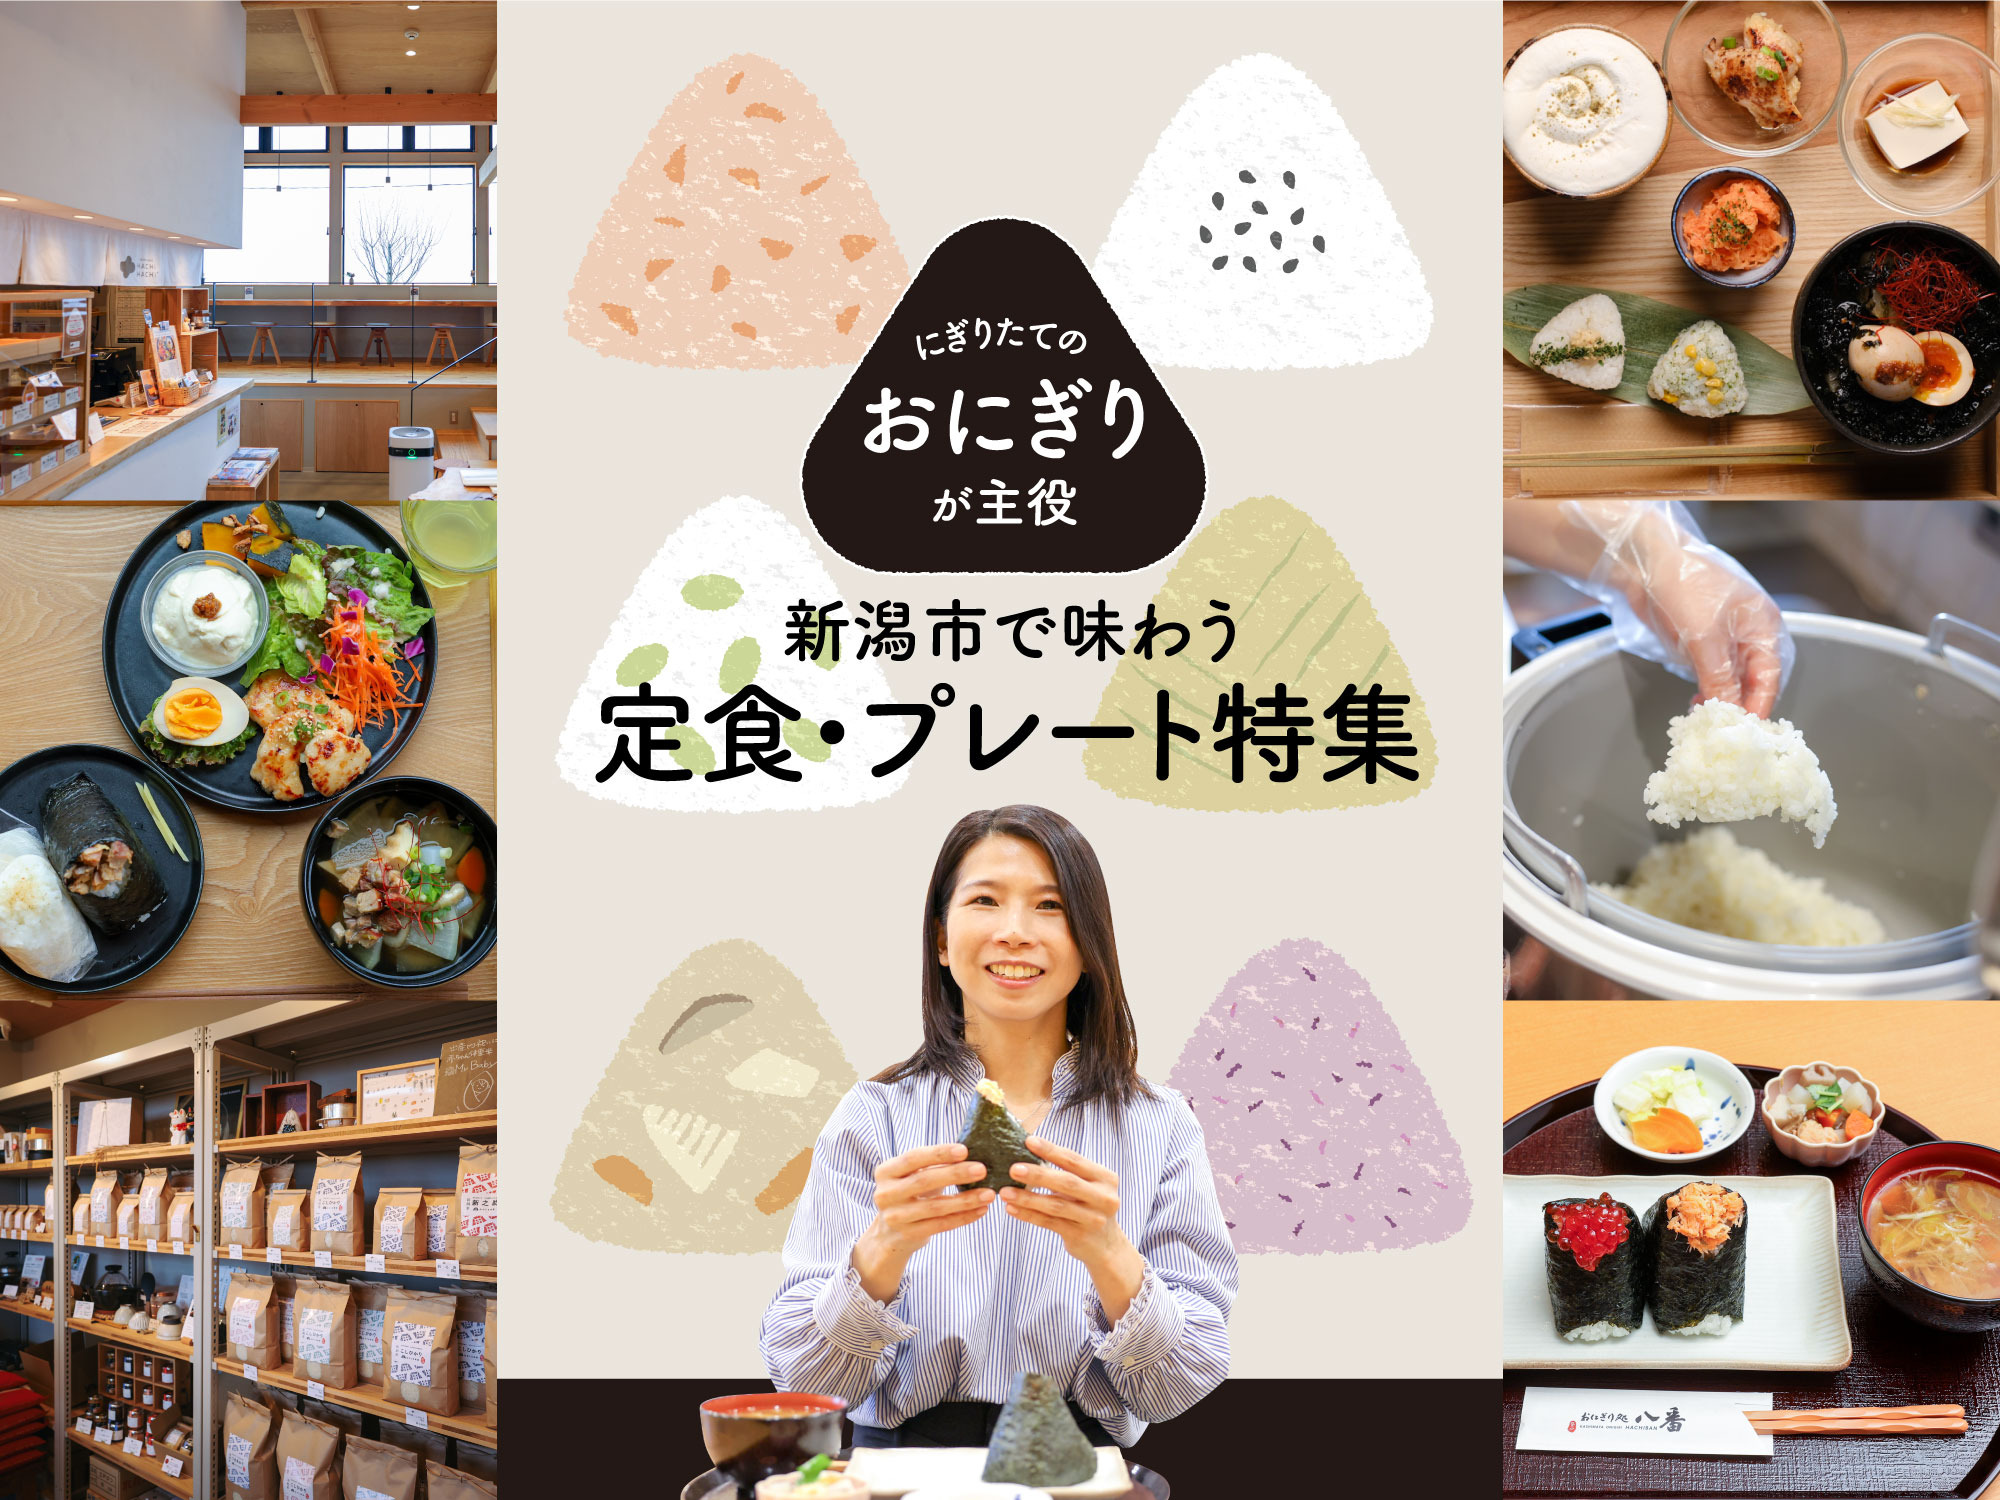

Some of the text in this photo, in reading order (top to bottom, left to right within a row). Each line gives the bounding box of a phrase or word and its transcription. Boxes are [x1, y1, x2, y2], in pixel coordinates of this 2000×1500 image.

[1580, 1406, 1686, 1432] おにぎり処 八番
